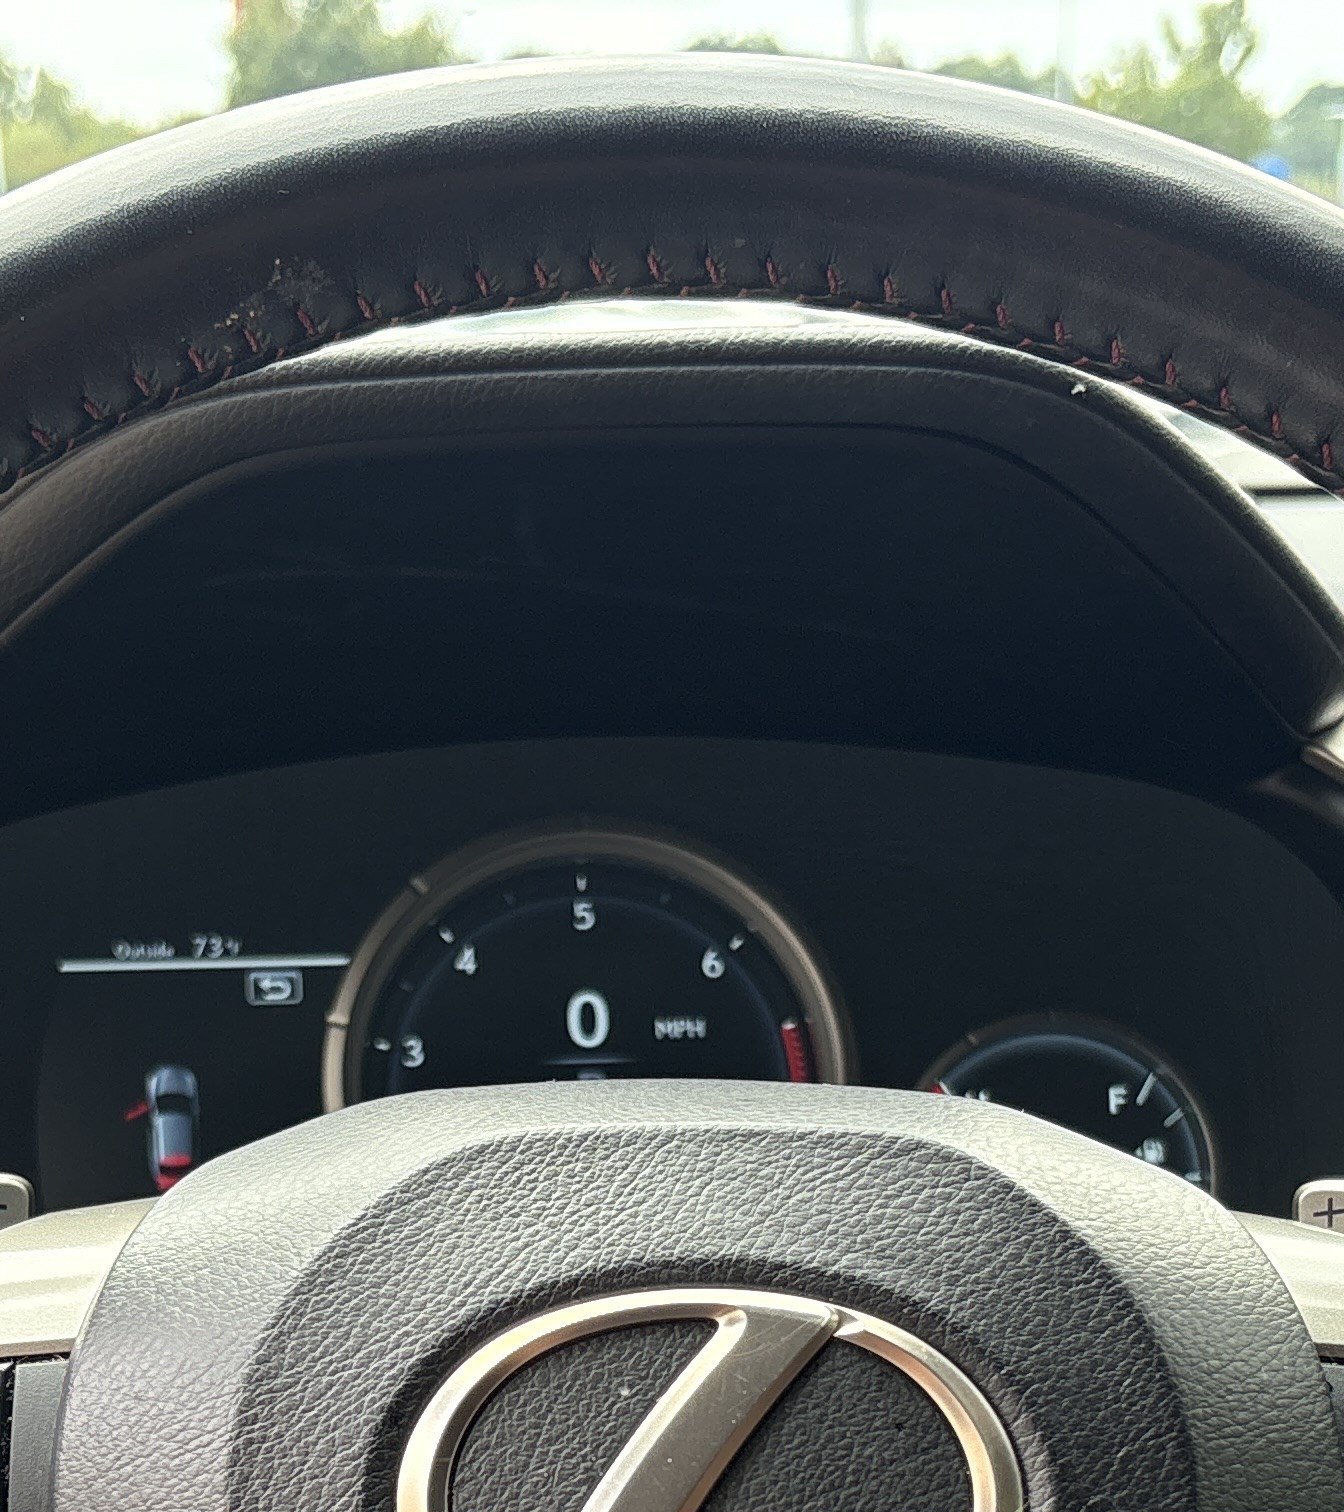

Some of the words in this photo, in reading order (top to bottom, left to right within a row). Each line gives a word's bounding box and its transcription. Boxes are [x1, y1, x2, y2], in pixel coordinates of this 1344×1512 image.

[571, 900, 596, 932] 5
[454, 943, 478, 976] 4
[701, 946, 725, 979] 6
[564, 986, 612, 1051] 0
[401, 1036, 426, 1069] 3
[1108, 1083, 1129, 1116] F
